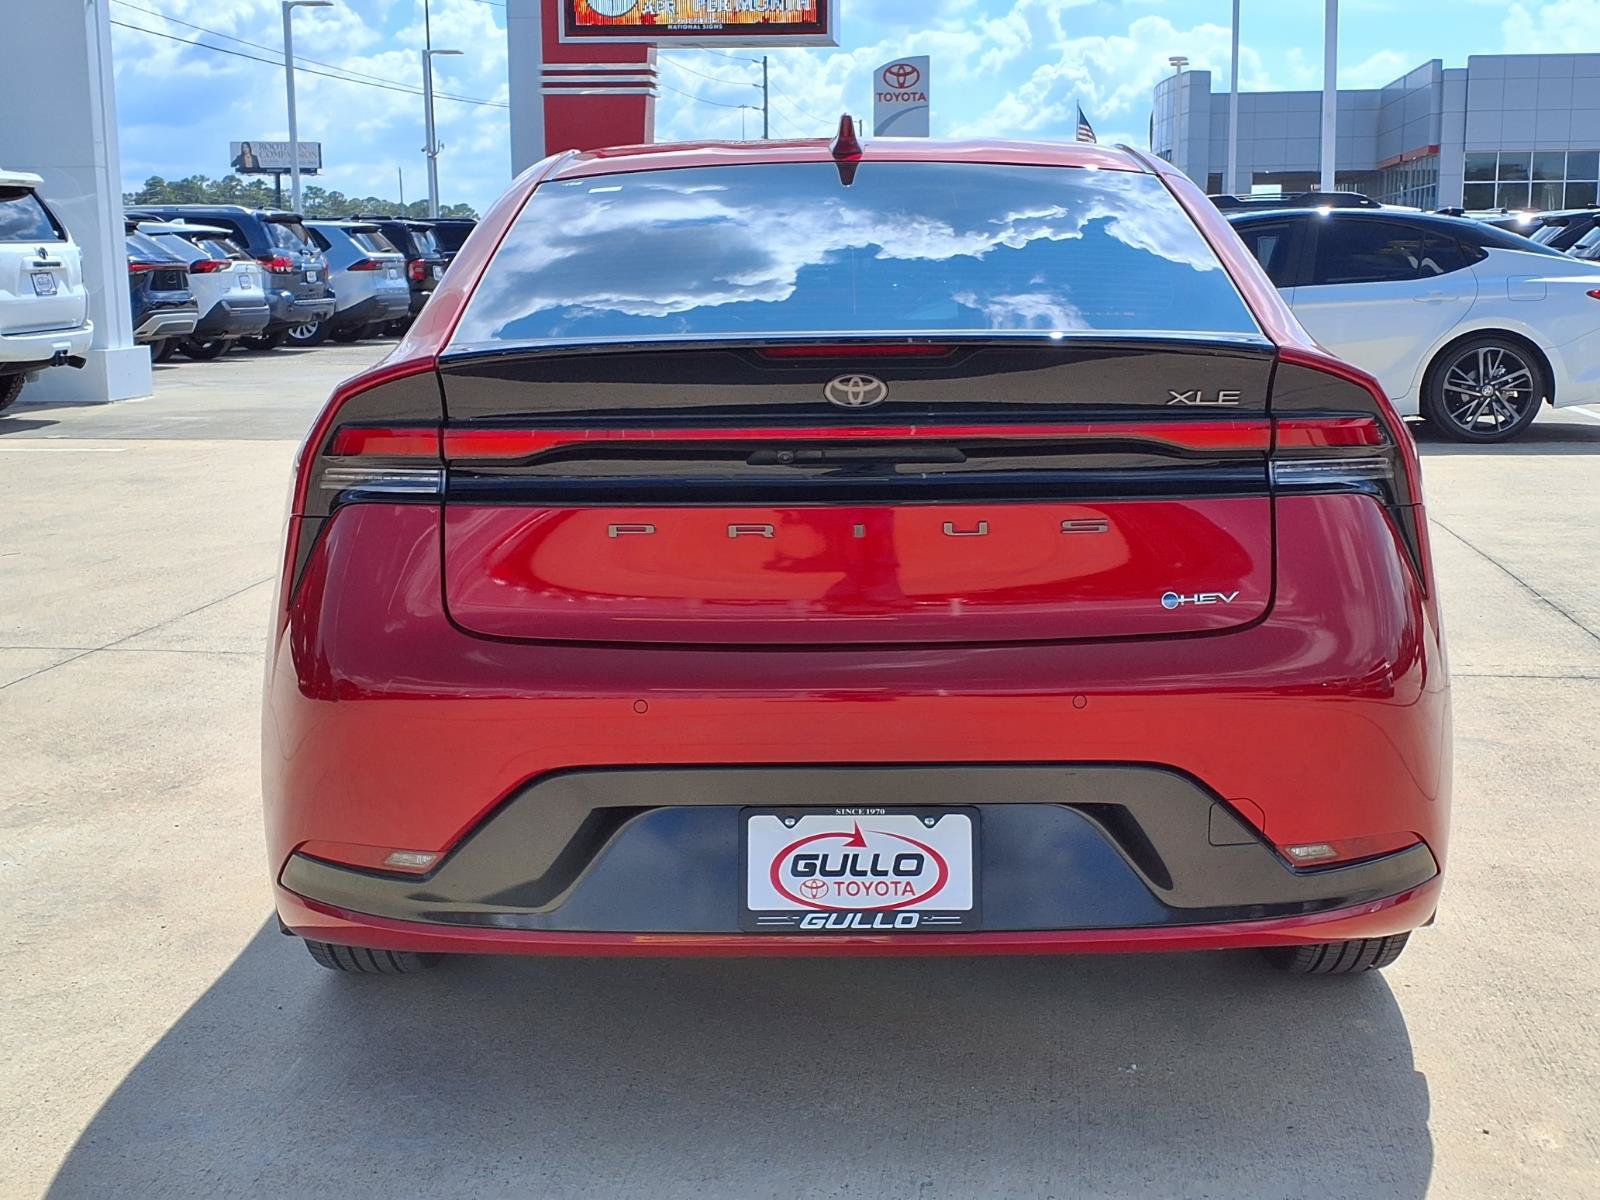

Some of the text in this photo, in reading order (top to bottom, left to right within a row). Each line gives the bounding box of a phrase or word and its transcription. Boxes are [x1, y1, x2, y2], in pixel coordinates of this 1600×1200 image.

[876, 92, 927, 102] TOYOTA
[1166, 390, 1241, 405] XLE
[607, 519, 1109, 538] PRIUS
[1180, 591, 1240, 606] HEV
[790, 853, 925, 878] GULLO
[833, 881, 916, 897] TOYOTA
[799, 912, 920, 929] GULLO
